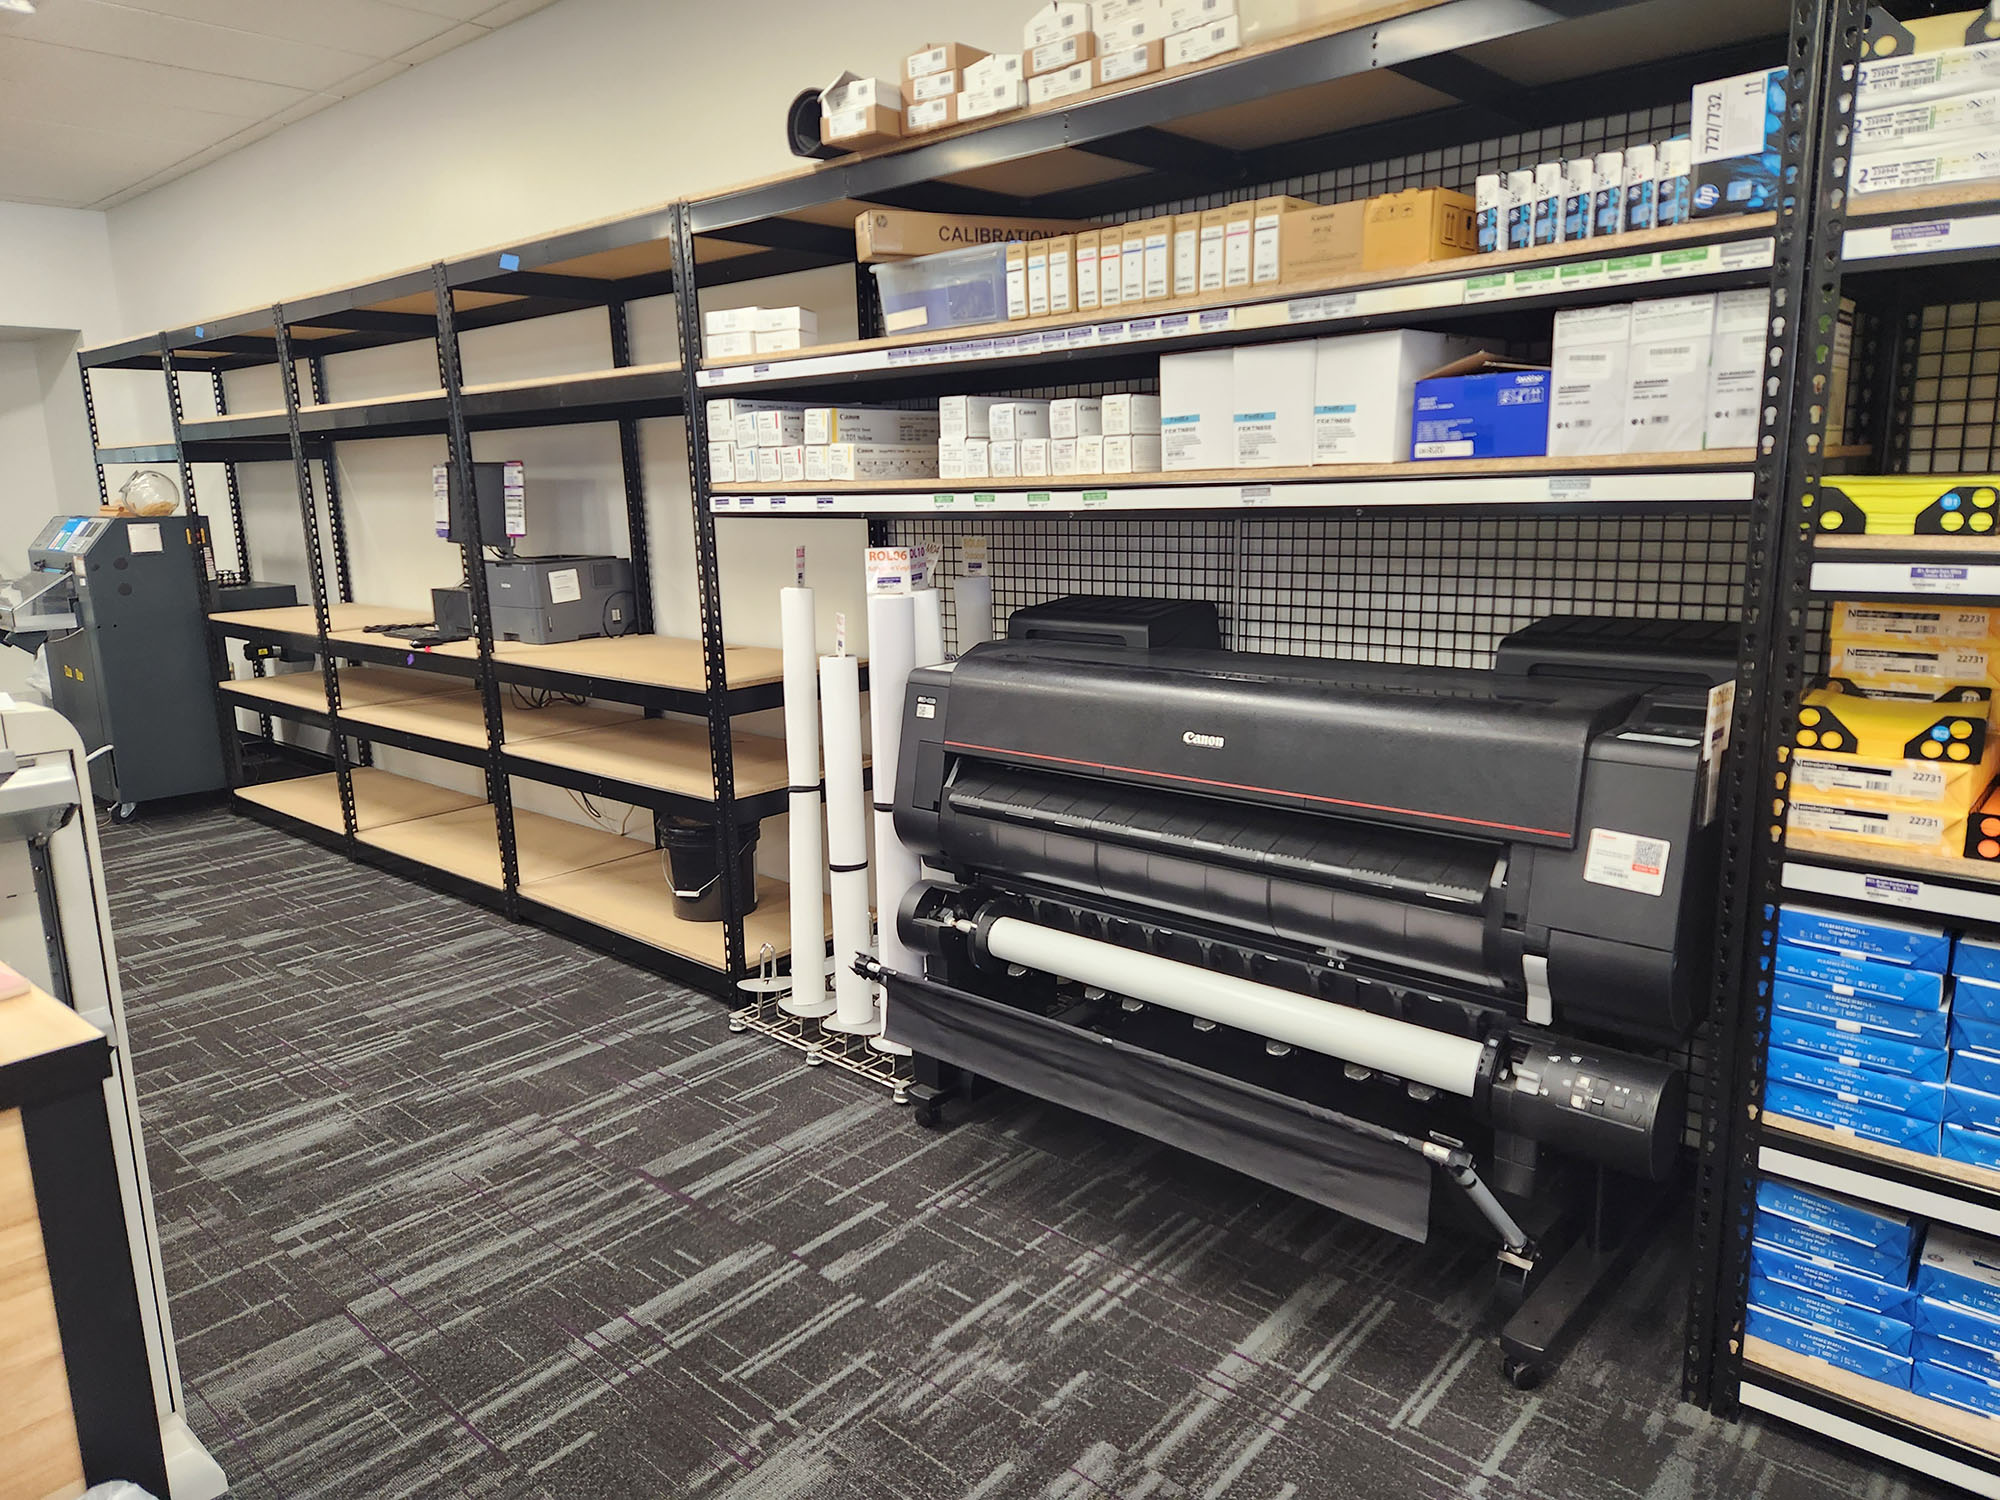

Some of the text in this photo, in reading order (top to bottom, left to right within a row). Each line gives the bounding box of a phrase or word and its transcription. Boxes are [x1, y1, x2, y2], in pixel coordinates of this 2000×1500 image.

[1857, 71, 1868, 86] 2
[1705, 93, 1723, 154] 727/732
[1858, 168, 1869, 184] 2
[1695, 184, 1720, 209] hp
[938, 225, 1054, 243] CALIBRATION
[1959, 614, 1987, 624] 22731
[1957, 655, 1985, 664] 22731
[1183, 731, 1225, 748] Canon
[1912, 771, 1942, 784] 22731
[1909, 815, 1938, 828] 22731
